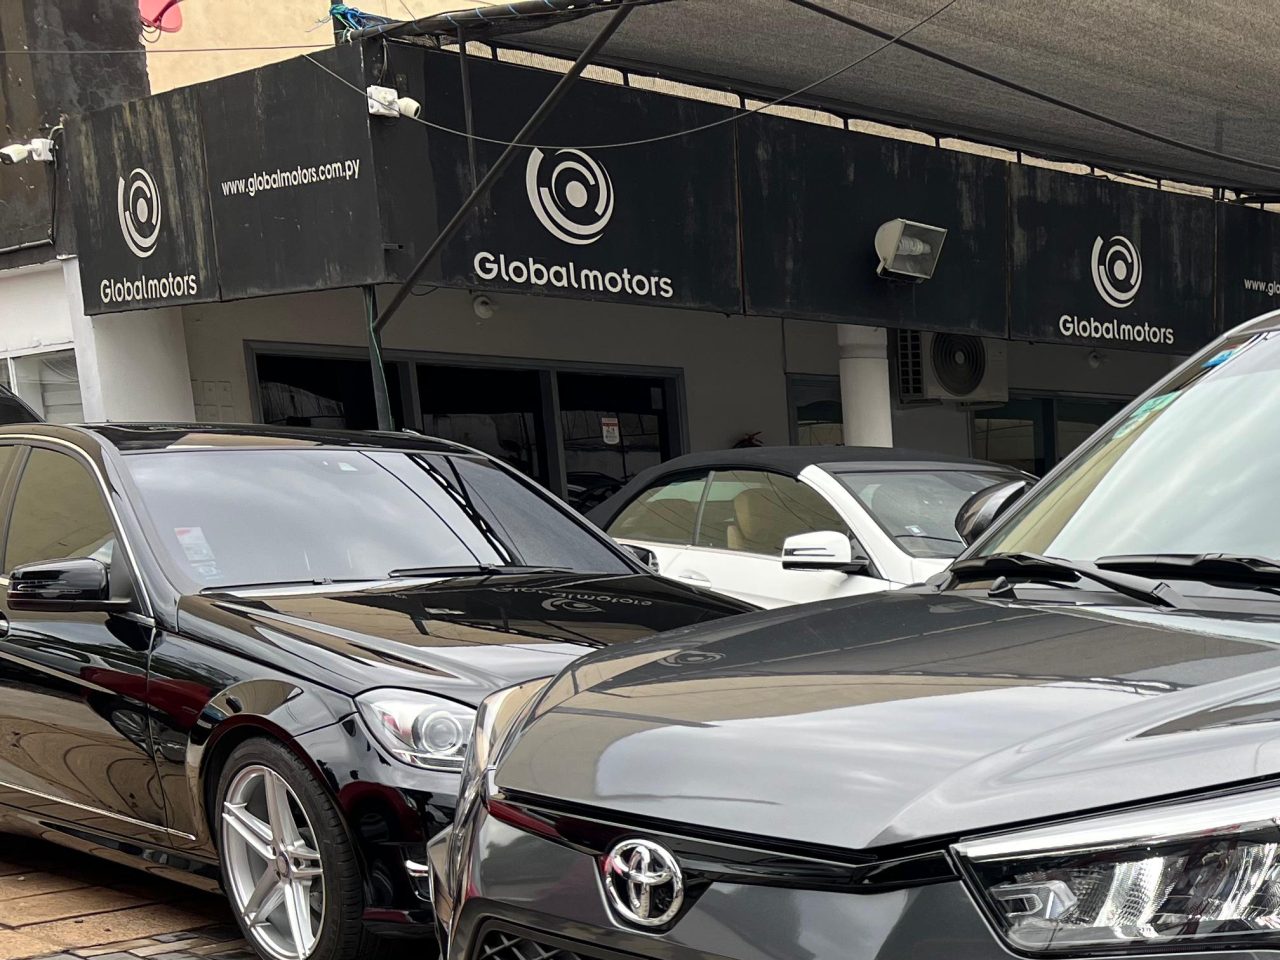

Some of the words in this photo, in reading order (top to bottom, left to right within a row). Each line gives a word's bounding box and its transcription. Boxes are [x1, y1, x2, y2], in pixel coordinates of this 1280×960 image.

[221, 158, 360, 197] www.globalmotors.com.py
[100, 272, 198, 304] Globalmotors
[473, 251, 674, 298] Globalmotors
[1059, 314, 1174, 344] Globalmotors
